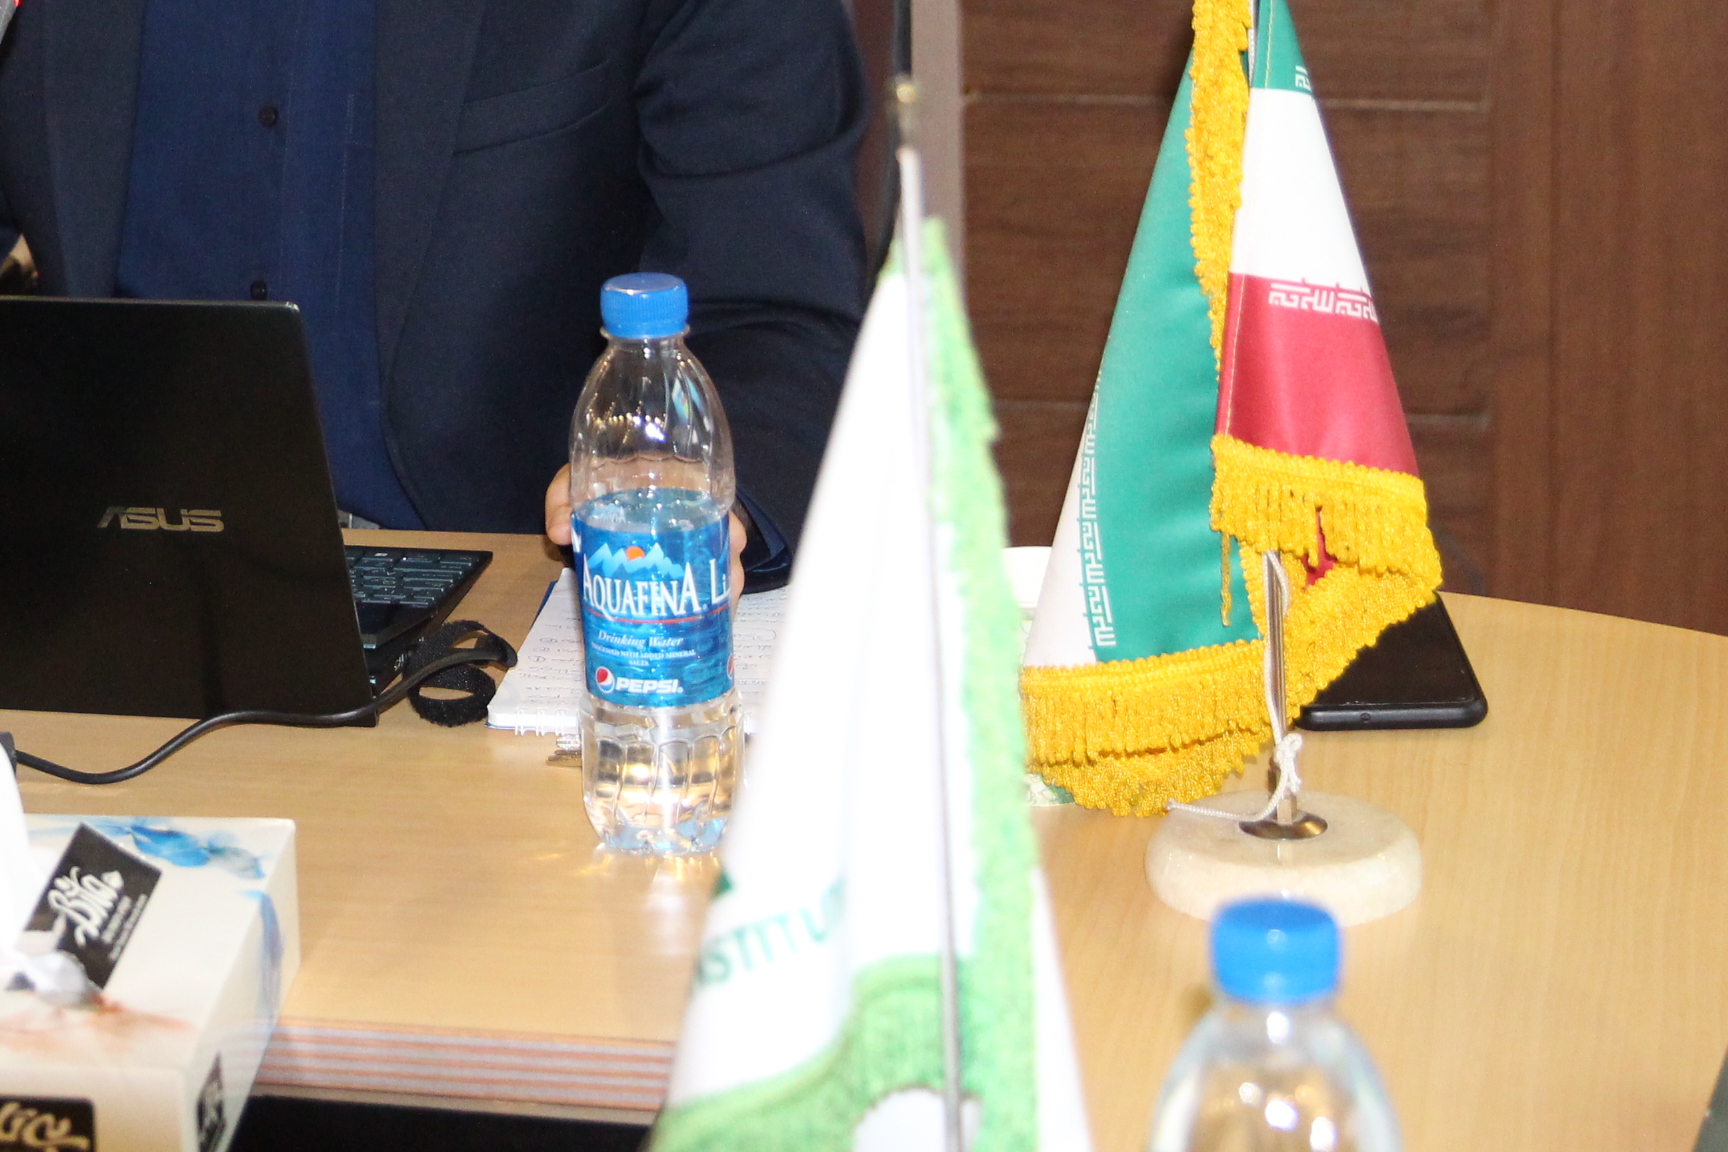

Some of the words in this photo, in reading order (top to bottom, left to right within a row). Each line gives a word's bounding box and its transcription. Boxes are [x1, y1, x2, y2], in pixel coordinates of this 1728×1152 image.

[97, 505, 225, 532] ASUS
[583, 553, 702, 621] AQUAFINA
[598, 630, 646, 650] Drinking
[648, 636, 684, 648] Water
[615, 677, 679, 694] PEPSI
